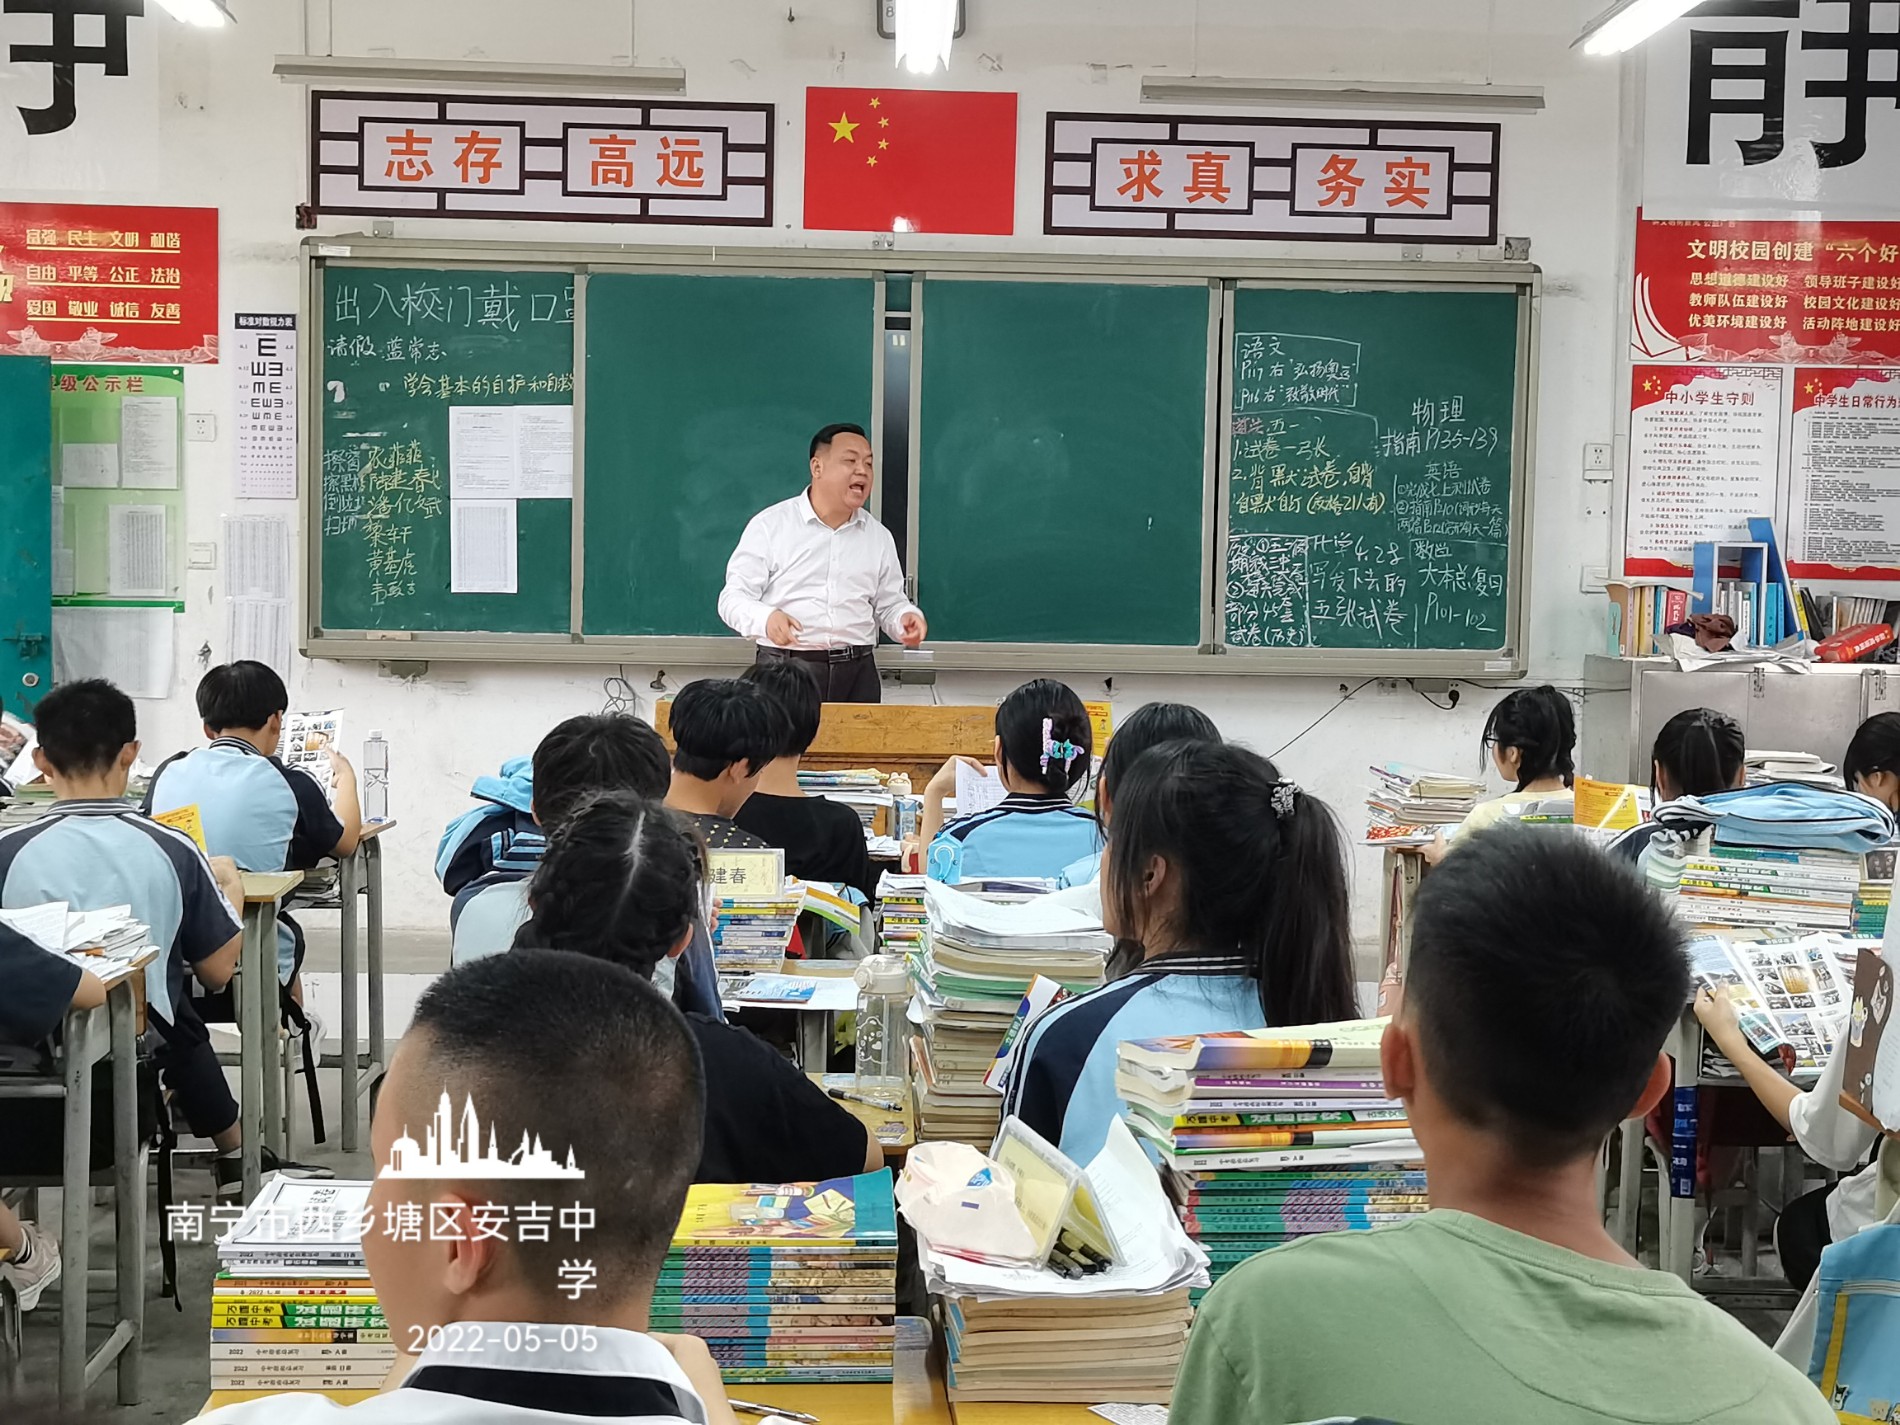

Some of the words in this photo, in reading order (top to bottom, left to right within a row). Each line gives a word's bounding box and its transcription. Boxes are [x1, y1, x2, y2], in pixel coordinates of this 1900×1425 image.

[385, 128, 504, 185] 志存
[589, 134, 705, 188] 高远
[1116, 148, 1231, 203] 求真
[1316, 154, 1431, 209] 务实
[26, 229, 57, 247] 富强
[68, 229, 98, 248] 民主
[109, 230, 140, 248] 文明
[150, 231, 181, 249] 和谐
[1686, 239, 1814, 262] 文明校园创建
[26, 265, 57, 283] 自由
[68, 265, 99, 283] 平等
[109, 266, 140, 283] 公正
[150, 267, 181, 284] 法治
[1689, 272, 1789, 288] 思想道德建设好
[1804, 274, 1900, 291] 领导班子建设好
[26, 300, 57, 317] 爱国
[68, 300, 99, 318] 敬业
[110, 301, 140, 318] 诚信
[150, 301, 181, 319] 友善
[1689, 293, 1789, 309] 教师队伍建设好
[1803, 295, 1900, 312] 校园文化建设好
[1688, 313, 1788, 330] 优美环境建设好
[1802, 315, 1900, 332] 活动阵地建设好
[1240, 336, 1286, 359] 语文
[50, 375, 145, 392] 级公示栏
[1665, 391, 1755, 406] 中小学生守则
[1814, 394, 1900, 409] 中学生日常行为
[1411, 395, 1466, 427] 物理
[1423, 459, 1463, 481] 英语
[1414, 540, 1453, 561] 数学
[1418, 561, 1504, 598] 大本总复习
